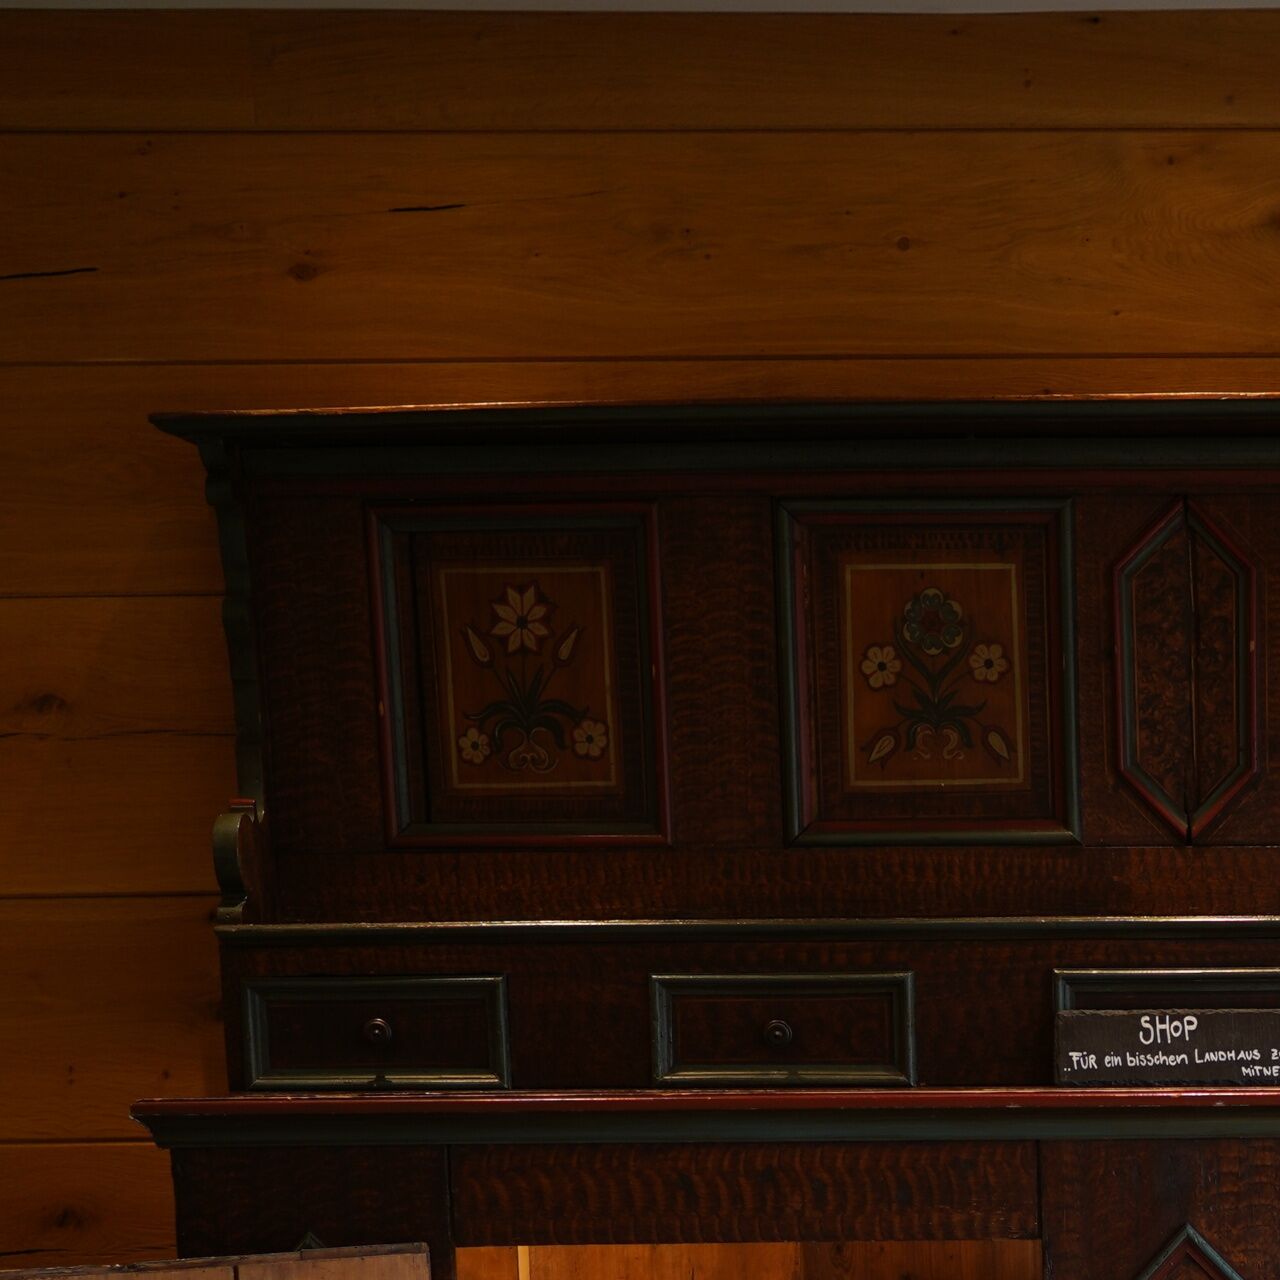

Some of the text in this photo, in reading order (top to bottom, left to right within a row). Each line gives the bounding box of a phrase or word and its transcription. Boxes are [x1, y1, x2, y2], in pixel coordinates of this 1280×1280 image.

[1139, 1015, 1198, 1045] SHOP
[1104, 1051, 1122, 1068] ein
[1126, 1051, 1188, 1067] bisschen
[1195, 1048, 1261, 1064] LANDHAUS
